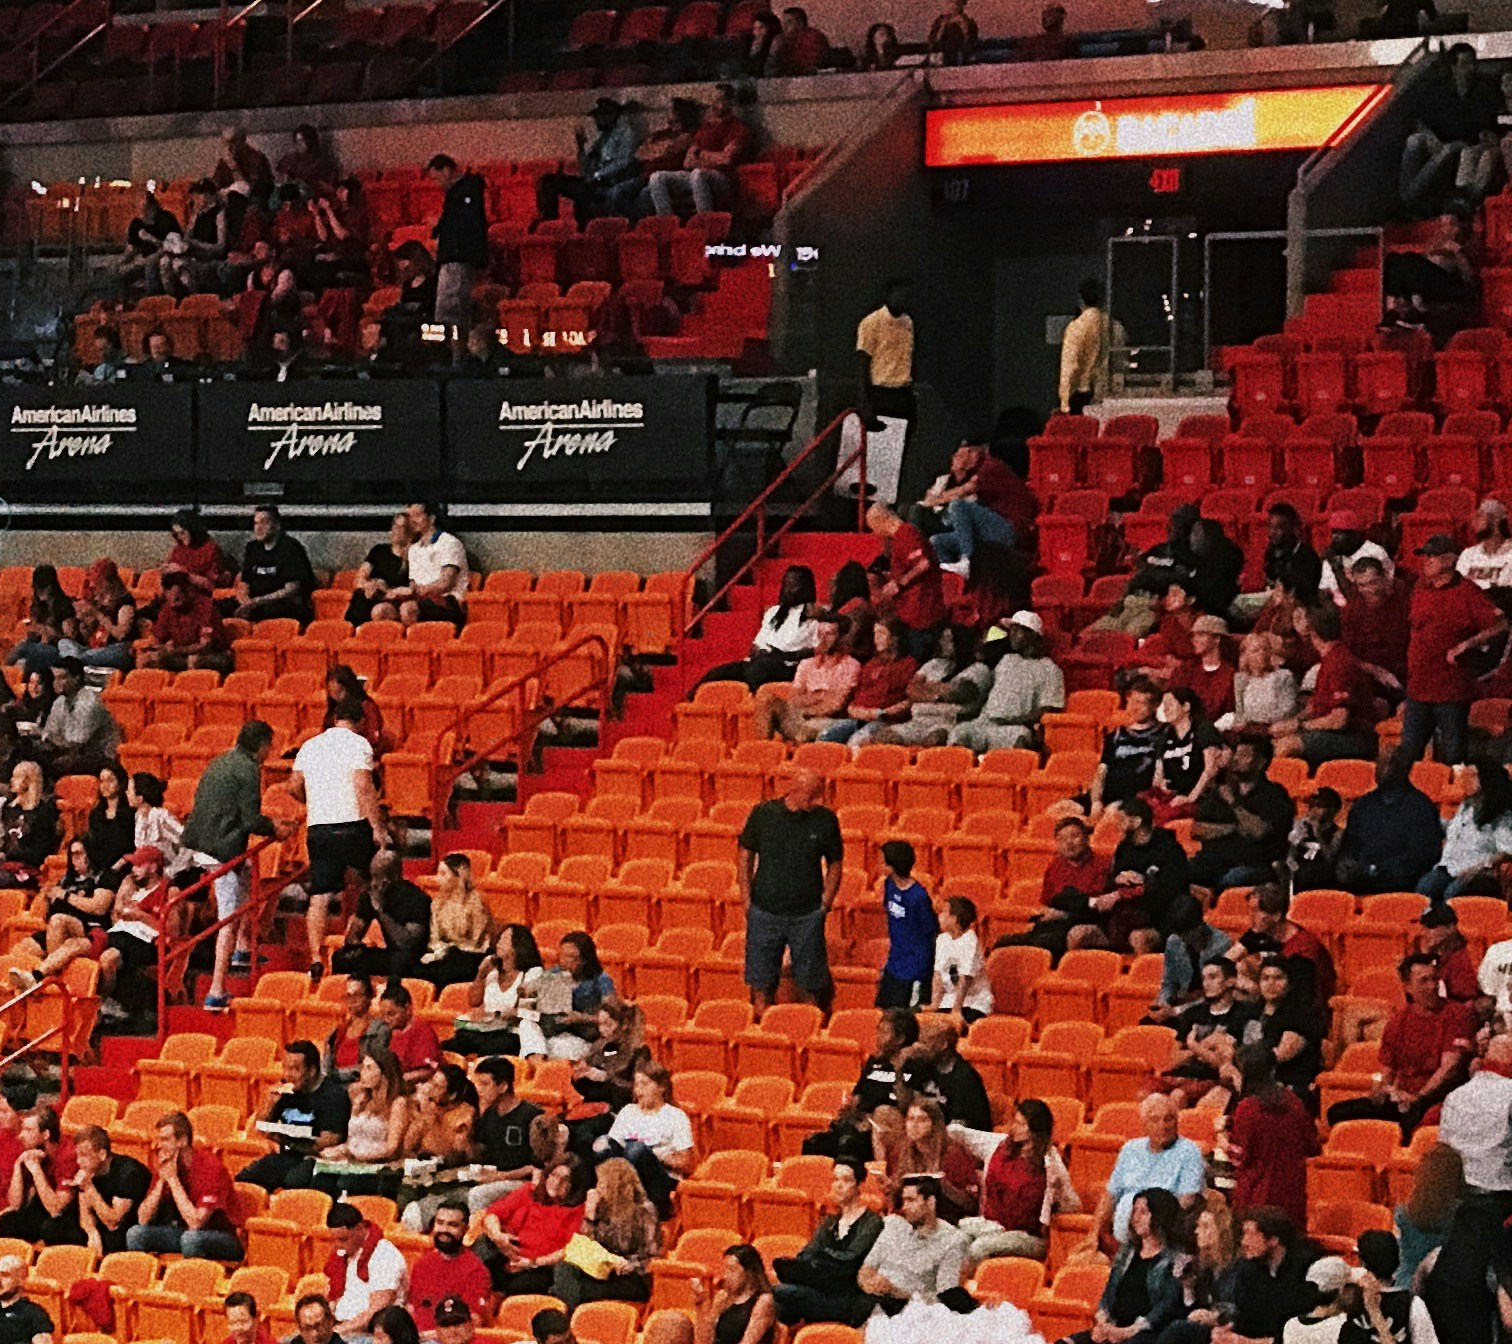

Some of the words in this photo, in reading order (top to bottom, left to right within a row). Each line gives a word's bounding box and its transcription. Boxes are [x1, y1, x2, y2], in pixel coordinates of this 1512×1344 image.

[11, 405, 137, 424] AmericanAirlines
[248, 401, 382, 422] AmericanAirlines
[498, 399, 644, 421] AmericanAirlines
[26, 424, 114, 471] Arena
[263, 422, 358, 471] Arena
[517, 421, 619, 471] Arena
